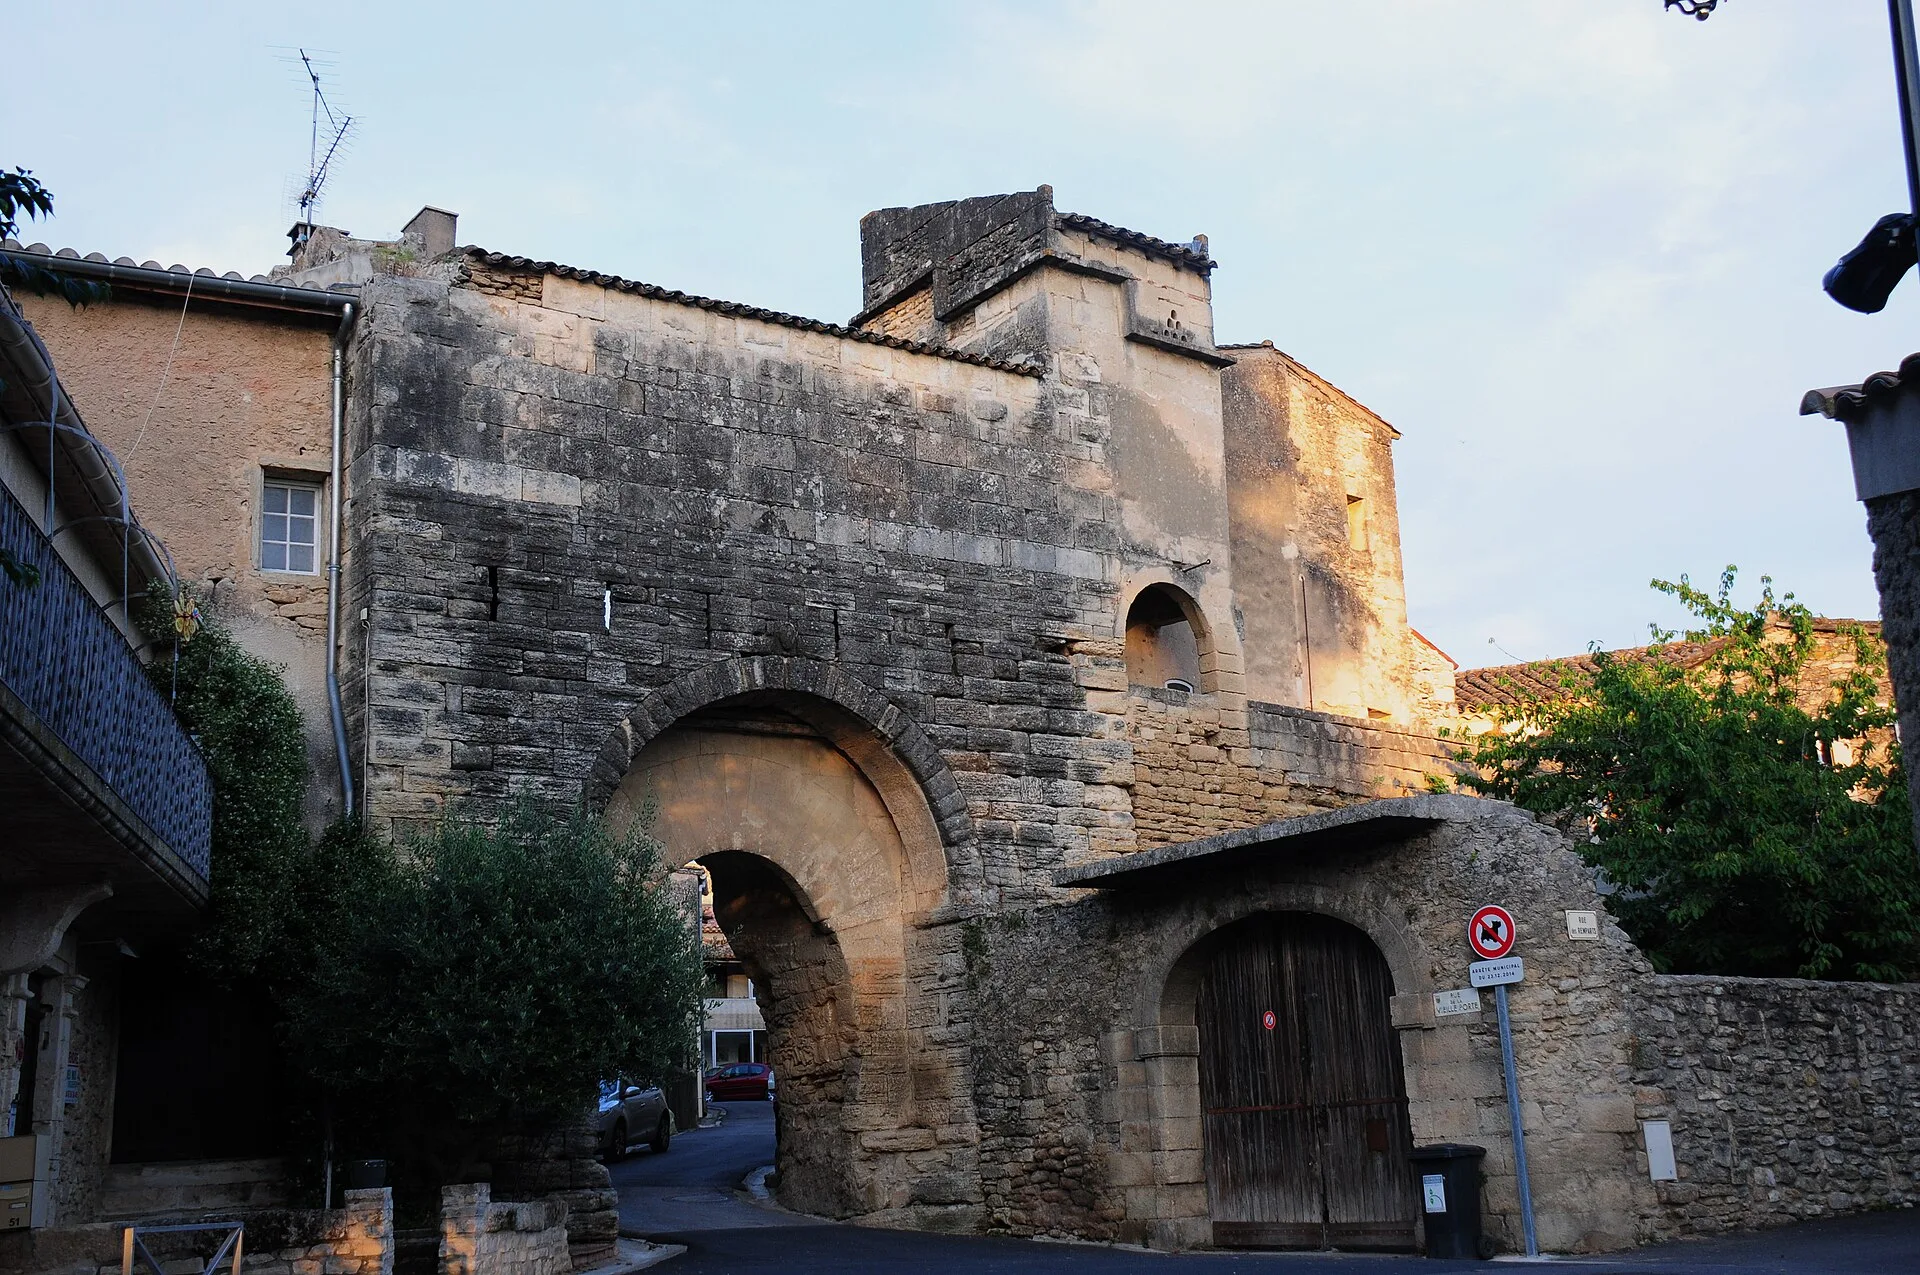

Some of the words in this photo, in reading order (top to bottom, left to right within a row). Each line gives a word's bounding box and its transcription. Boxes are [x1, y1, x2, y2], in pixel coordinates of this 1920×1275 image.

[1492, 963, 1520, 971] MUNICIPAL
[1458, 1002, 1478, 1012] PORTE
[9, 1217, 20, 1227] 51
